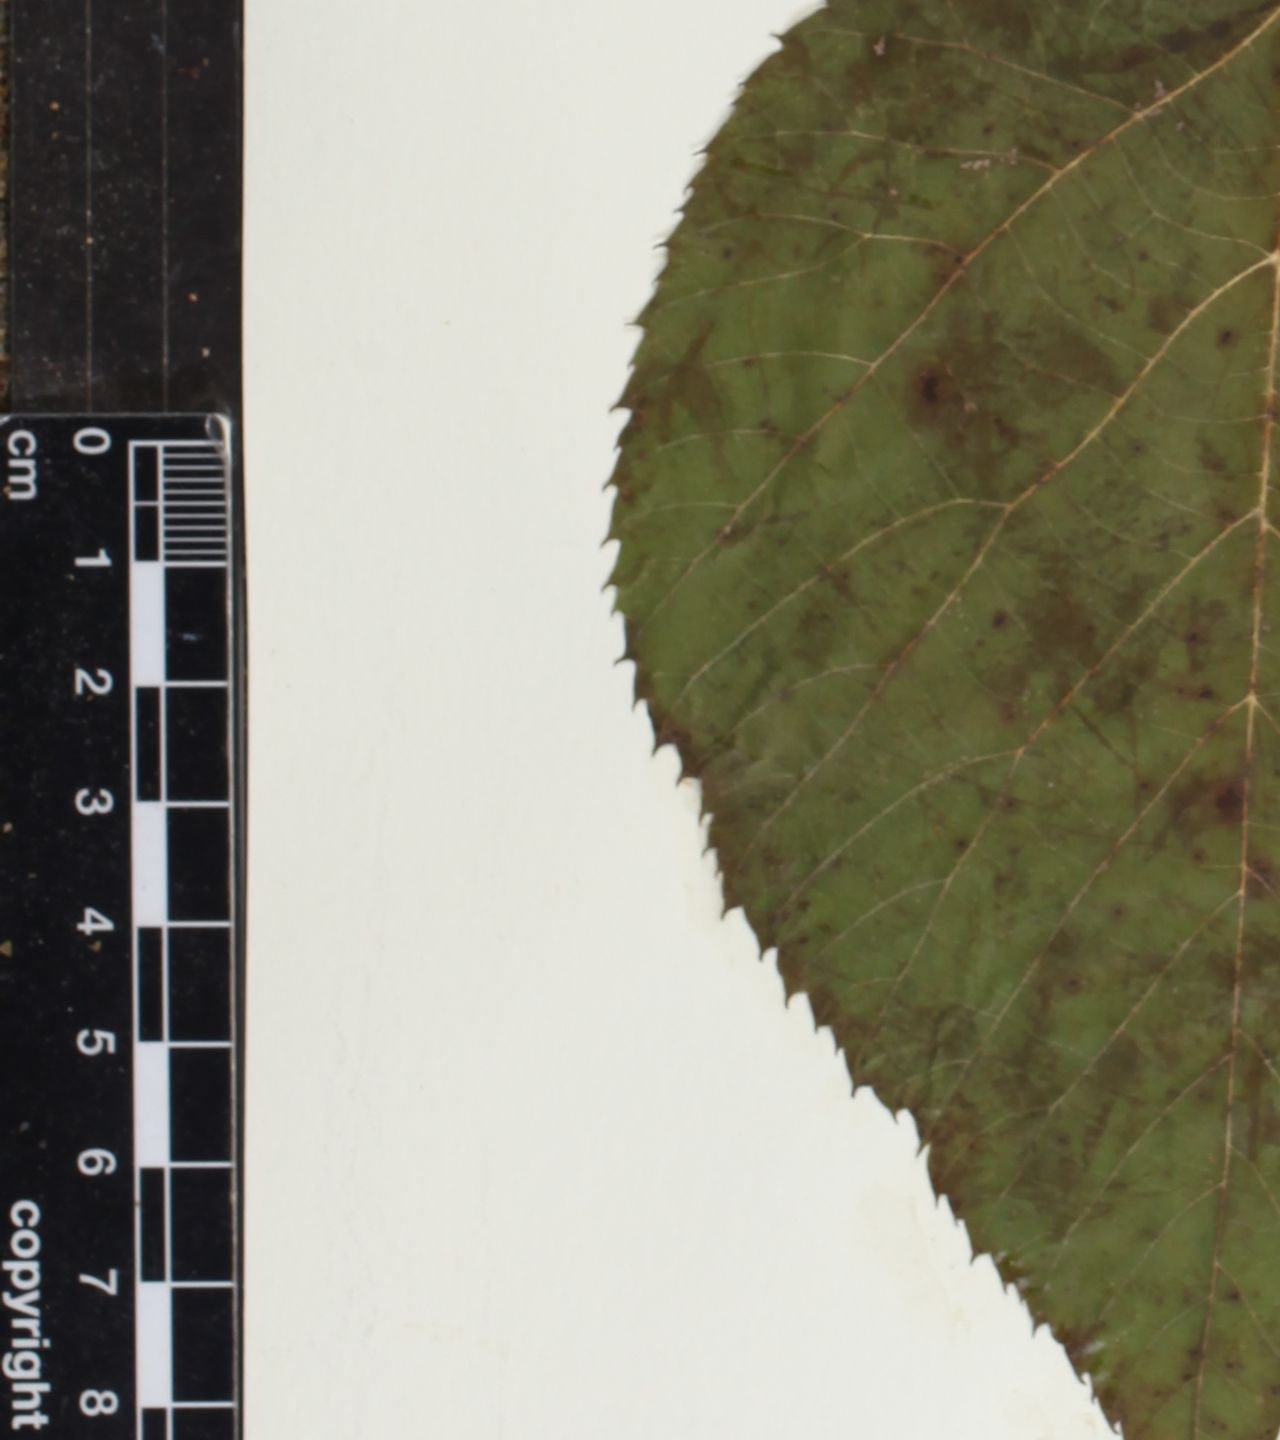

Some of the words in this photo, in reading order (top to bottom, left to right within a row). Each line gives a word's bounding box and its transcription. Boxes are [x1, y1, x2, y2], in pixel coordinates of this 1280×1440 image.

[72, 426, 112, 455] 0
[7, 429, 37, 500] cm
[74, 548, 112, 567] 1
[74, 668, 113, 695] 2
[74, 788, 114, 816] 3
[76, 907, 115, 936] 4
[76, 1029, 116, 1056] 5
[77, 1148, 117, 1176] 6
[78, 1268, 118, 1296] 7
[1, 1199, 51, 1430] copyright
[79, 1389, 119, 1417] 8
